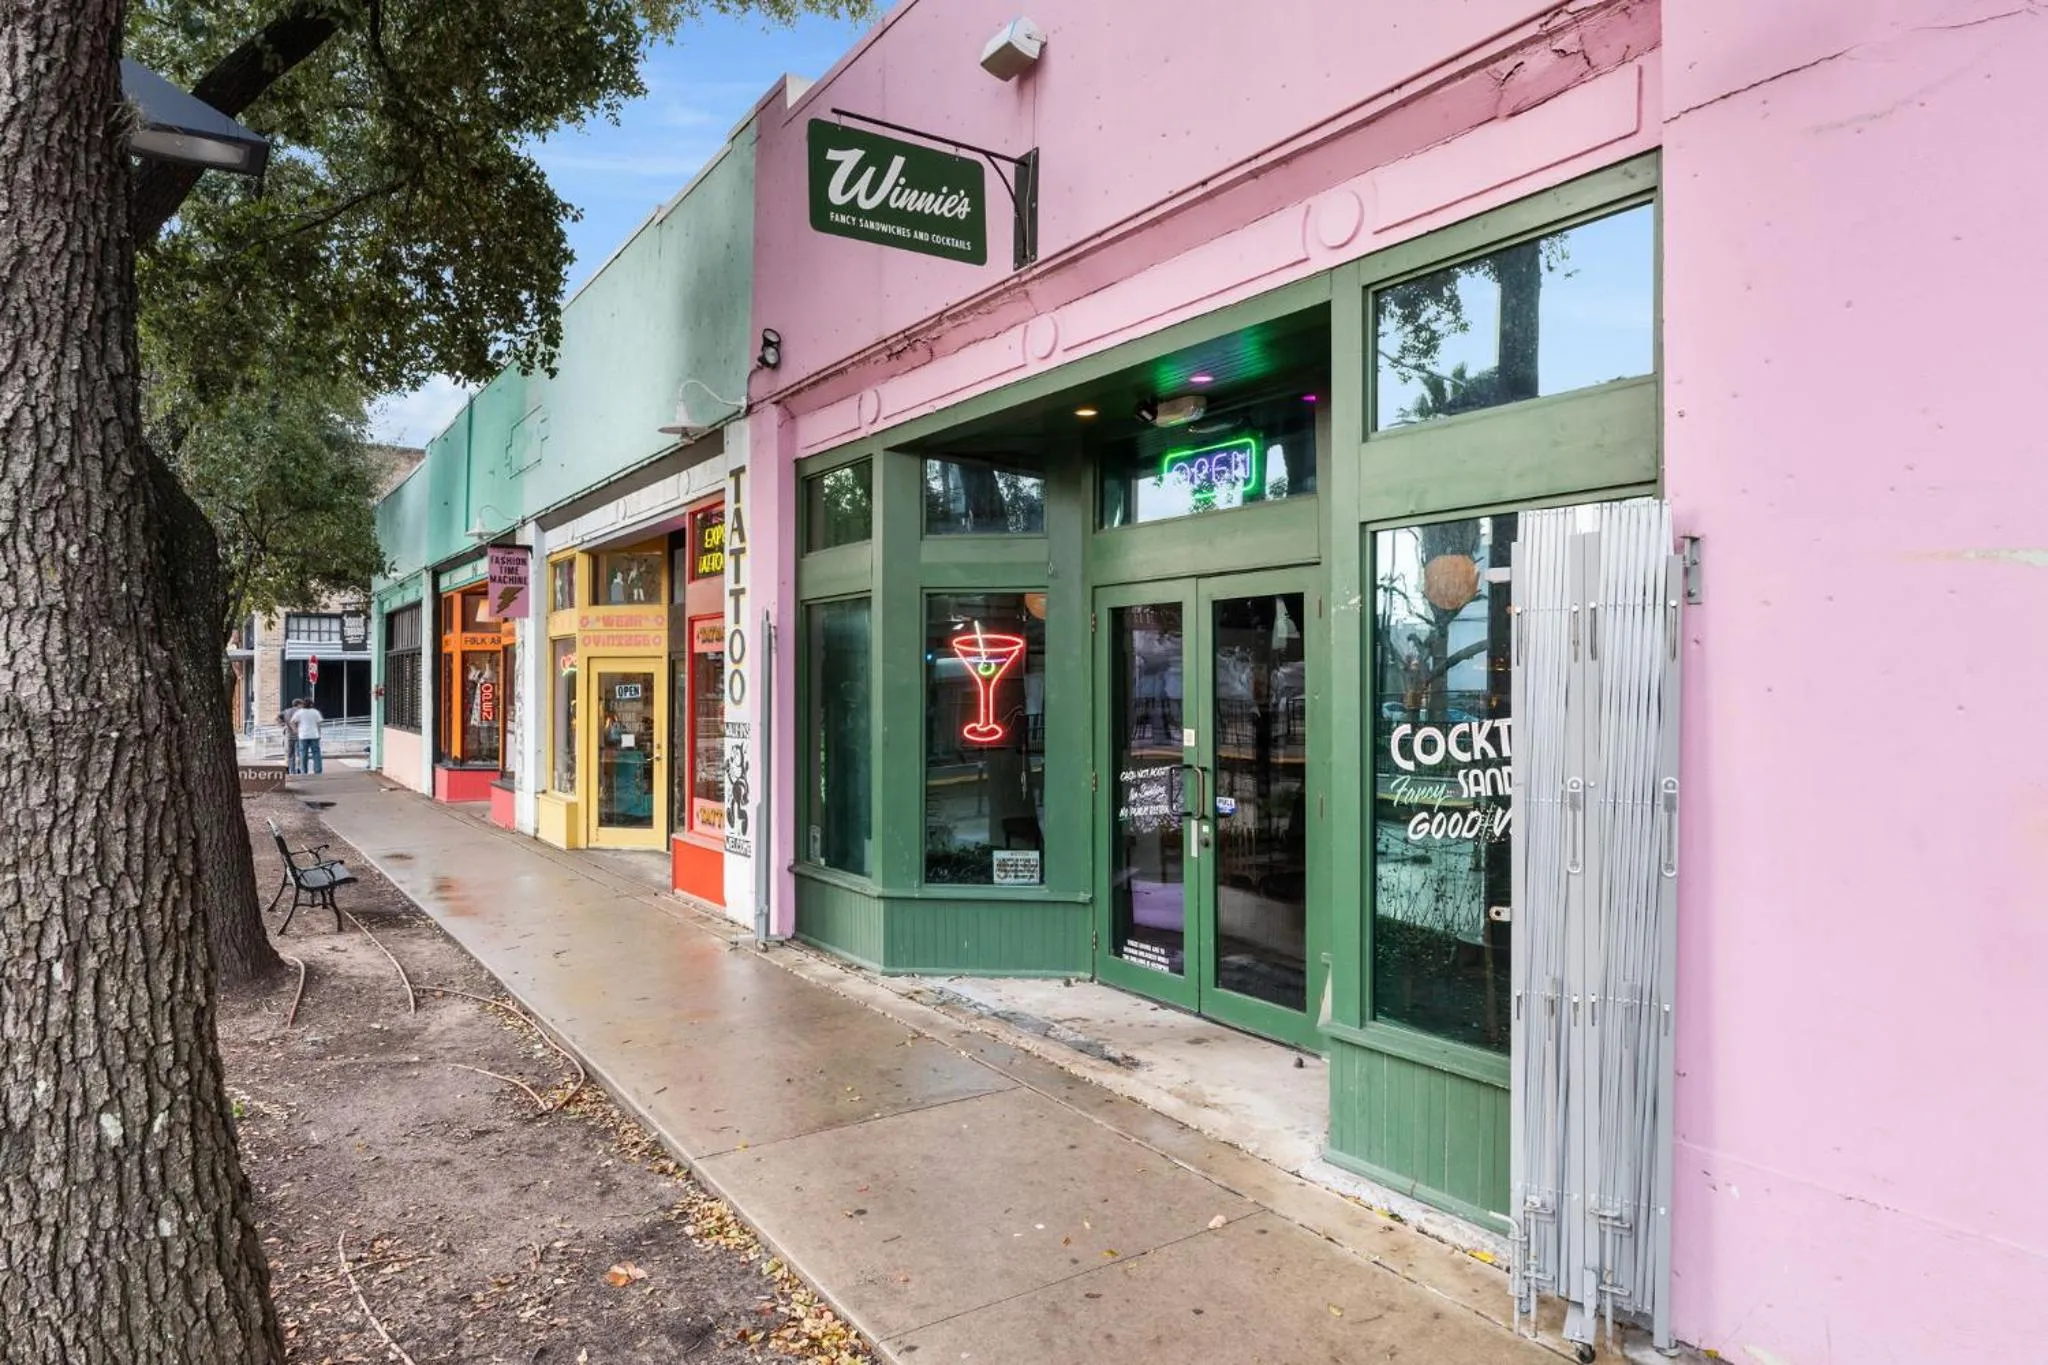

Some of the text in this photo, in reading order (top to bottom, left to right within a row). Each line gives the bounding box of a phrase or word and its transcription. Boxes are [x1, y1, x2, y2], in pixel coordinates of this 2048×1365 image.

[826, 148, 971, 219] Winnie's
[829, 211, 972, 251] FANCY SANDWICHES AND COCKTAILS
[1171, 448, 1250, 488] OPEN
[490, 556, 528, 566] FASHION
[490, 574, 528, 585] MACHINE
[499, 565, 519, 575] TIME
[729, 465, 746, 706] TATTOO
[481, 683, 493, 720] OPEN
[618, 686, 640, 697] OPEN
[1391, 718, 1512, 771] COCKT
[1391, 766, 1512, 813] Fancy SAND
[1408, 806, 1512, 840] GOOD V
